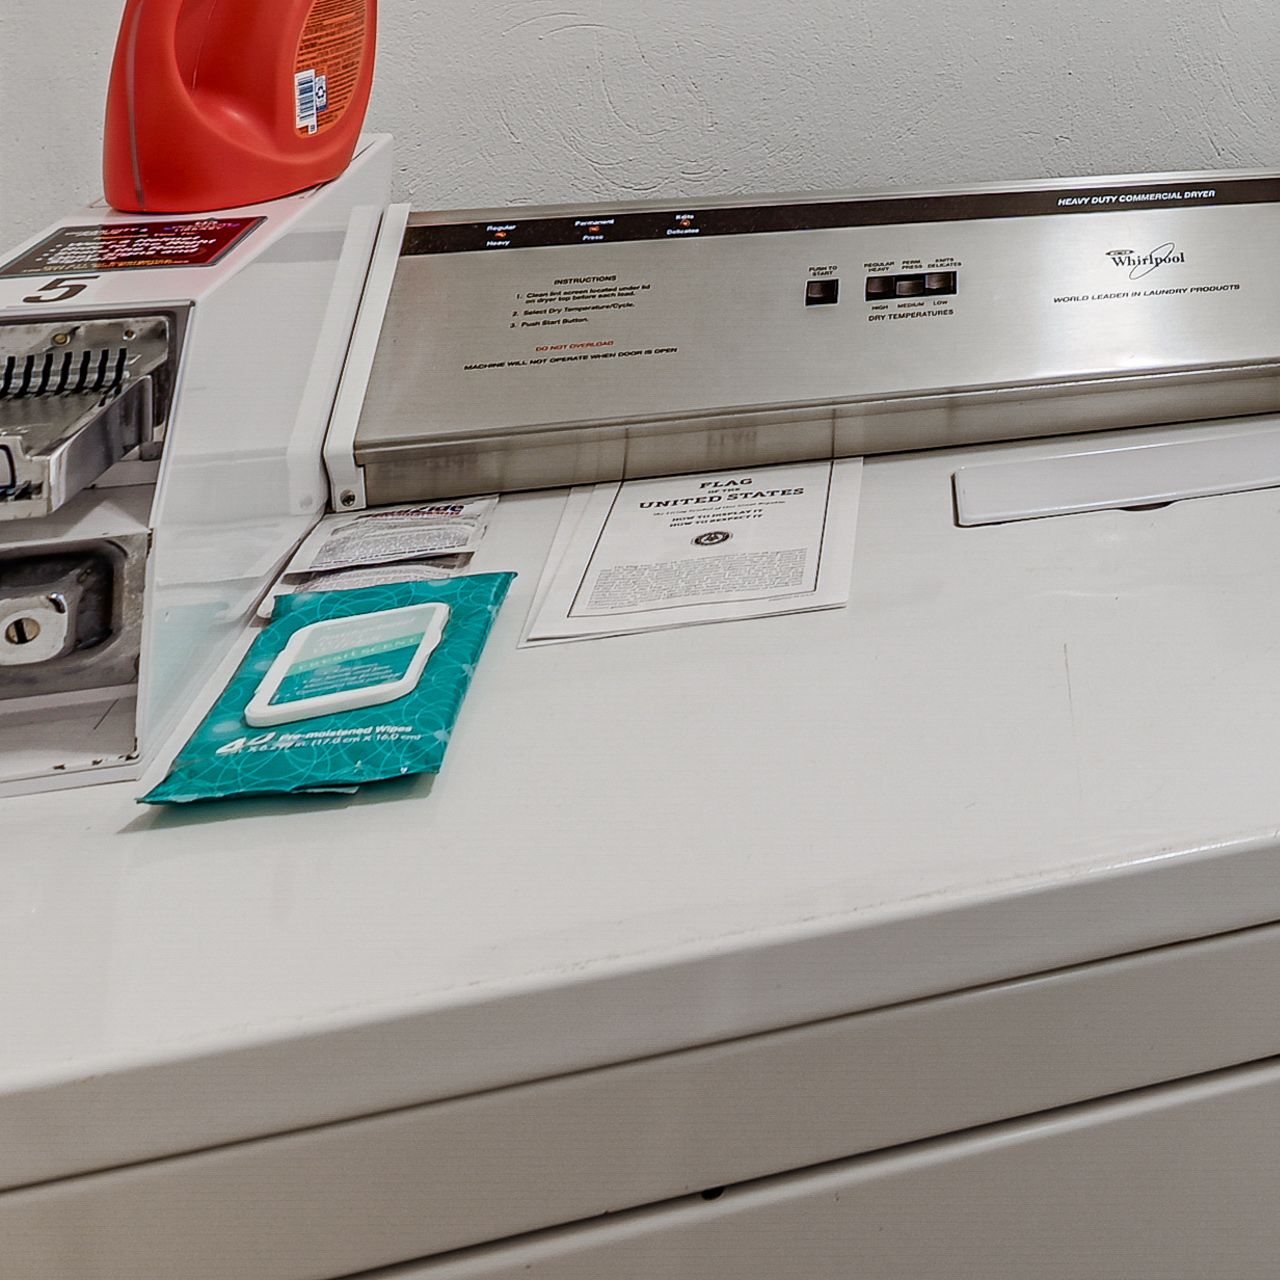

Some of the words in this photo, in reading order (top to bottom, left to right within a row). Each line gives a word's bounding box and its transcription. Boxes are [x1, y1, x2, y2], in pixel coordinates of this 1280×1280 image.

[1058, 197, 1090, 206] HEAVY
[1092, 196, 1118, 204] DUTY
[1119, 192, 1182, 203] COMMERCIAL
[1184, 190, 1215, 198] DRYER
[1112, 252, 1185, 268] Whirlpool
[554, 275, 616, 285] INSTRUCTIONS
[23, 276, 100, 303] 5
[1054, 295, 1089, 303] WORLD
[1092, 292, 1128, 300] LEADER
[1144, 288, 1188, 296] LAUNDRY
[1190, 284, 1240, 293] PRODUCTS
[888, 309, 954, 320] TEMPERATURES
[569, 340, 614, 349] OVERLOAD
[464, 362, 505, 370] MACHINE
[549, 355, 588, 363] OPERATE
[700, 478, 752, 489] FLAG
[639, 495, 722, 508] UNITED
[727, 488, 804, 501] STATES
[709, 515, 752, 523] RESPECT
[215, 732, 276, 755] 40
[278, 726, 373, 741] Pre-moistened
[375, 725, 412, 733] Wipes
